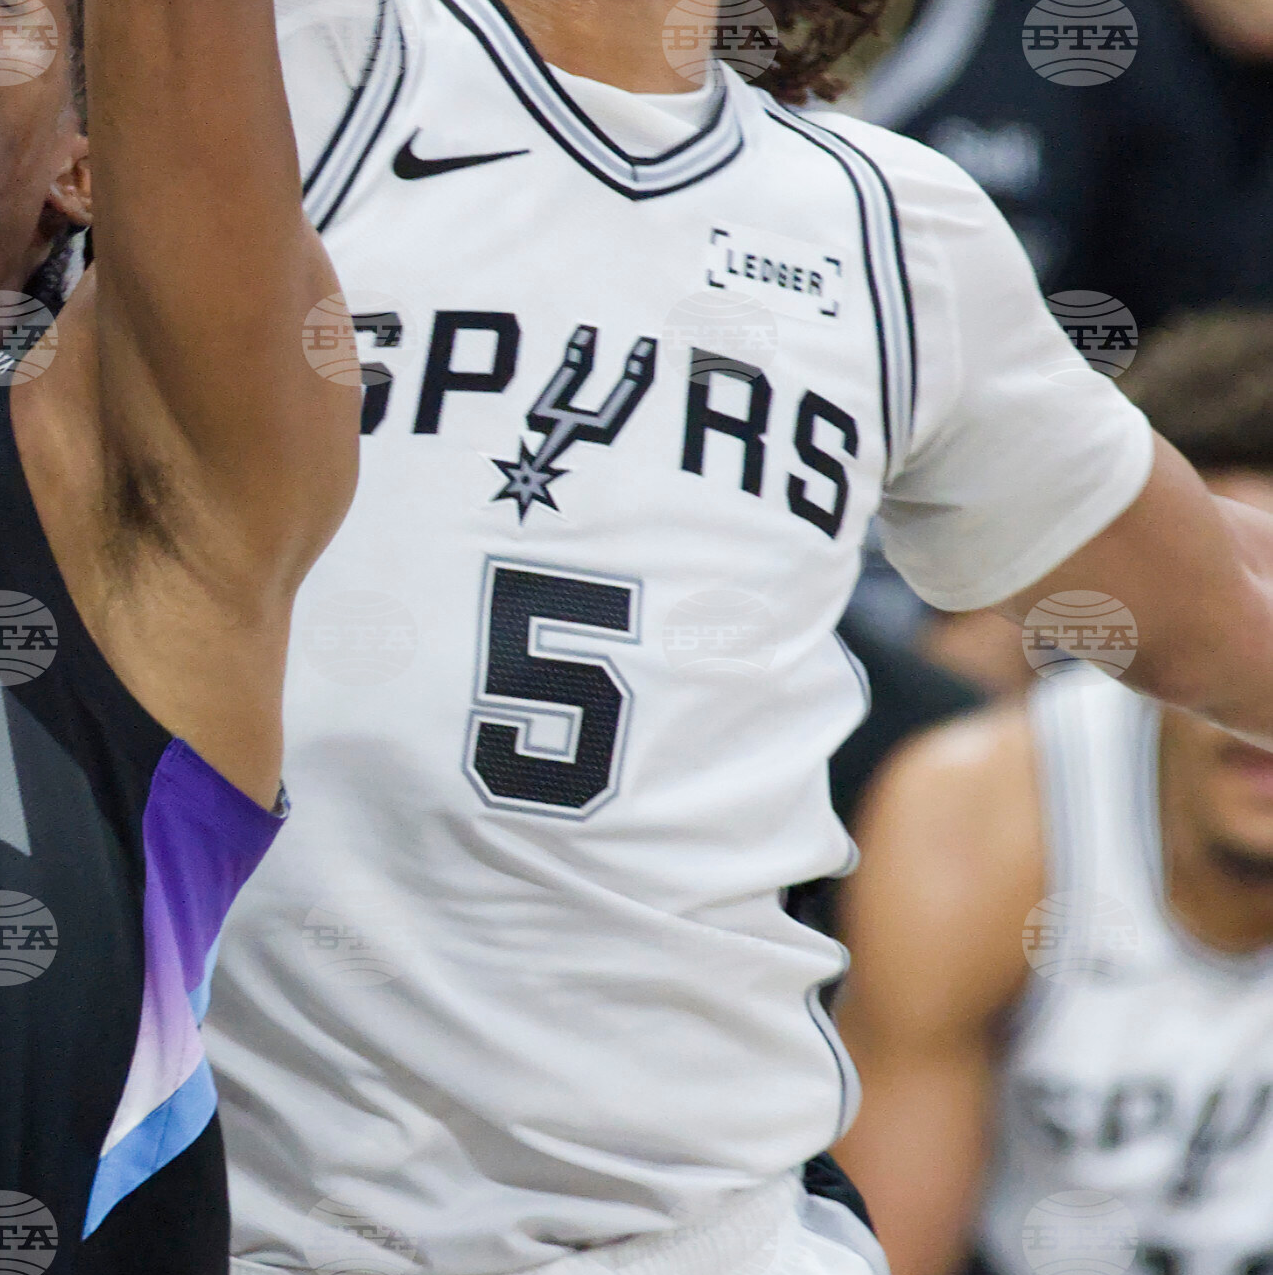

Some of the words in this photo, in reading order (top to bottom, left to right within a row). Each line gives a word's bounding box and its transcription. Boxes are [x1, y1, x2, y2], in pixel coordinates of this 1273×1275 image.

[727, 248, 823, 297] LEDGER
[350, 310, 860, 540] SPURS
[463, 553, 643, 822] 5
